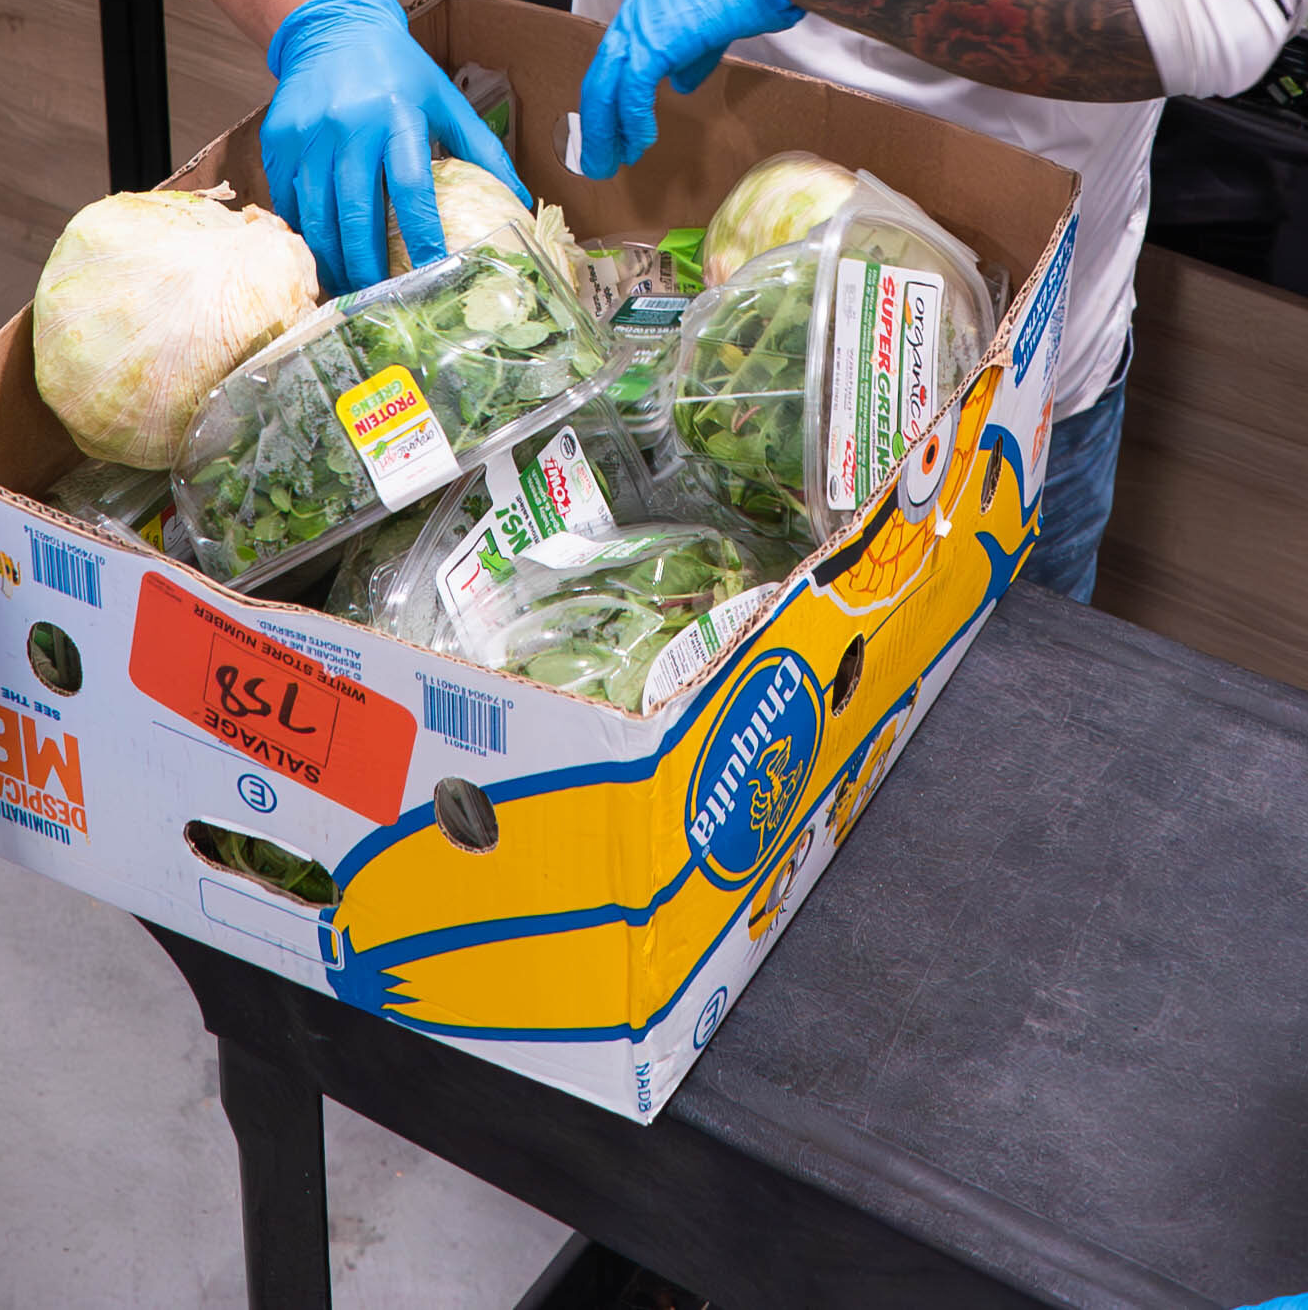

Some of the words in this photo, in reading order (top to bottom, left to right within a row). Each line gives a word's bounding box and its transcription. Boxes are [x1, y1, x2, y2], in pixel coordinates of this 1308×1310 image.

[351, 379, 403, 418] GREENS
[354, 390, 417, 437] PROTEIN
[194, 603, 258, 649] NUMBER
[262, 643, 314, 677] STORE
[307, 645, 362, 671] DESPICABLE
[309, 636, 342, 654] RIGHTS
[343, 647, 362, 660] ALL
[1, 686, 30, 708] THE
[317, 670, 366, 705] WRITE
[33, 700, 61, 722] SEE
[204, 707, 321, 785] SALVAGE
[689, 654, 802, 848] Chiquita
